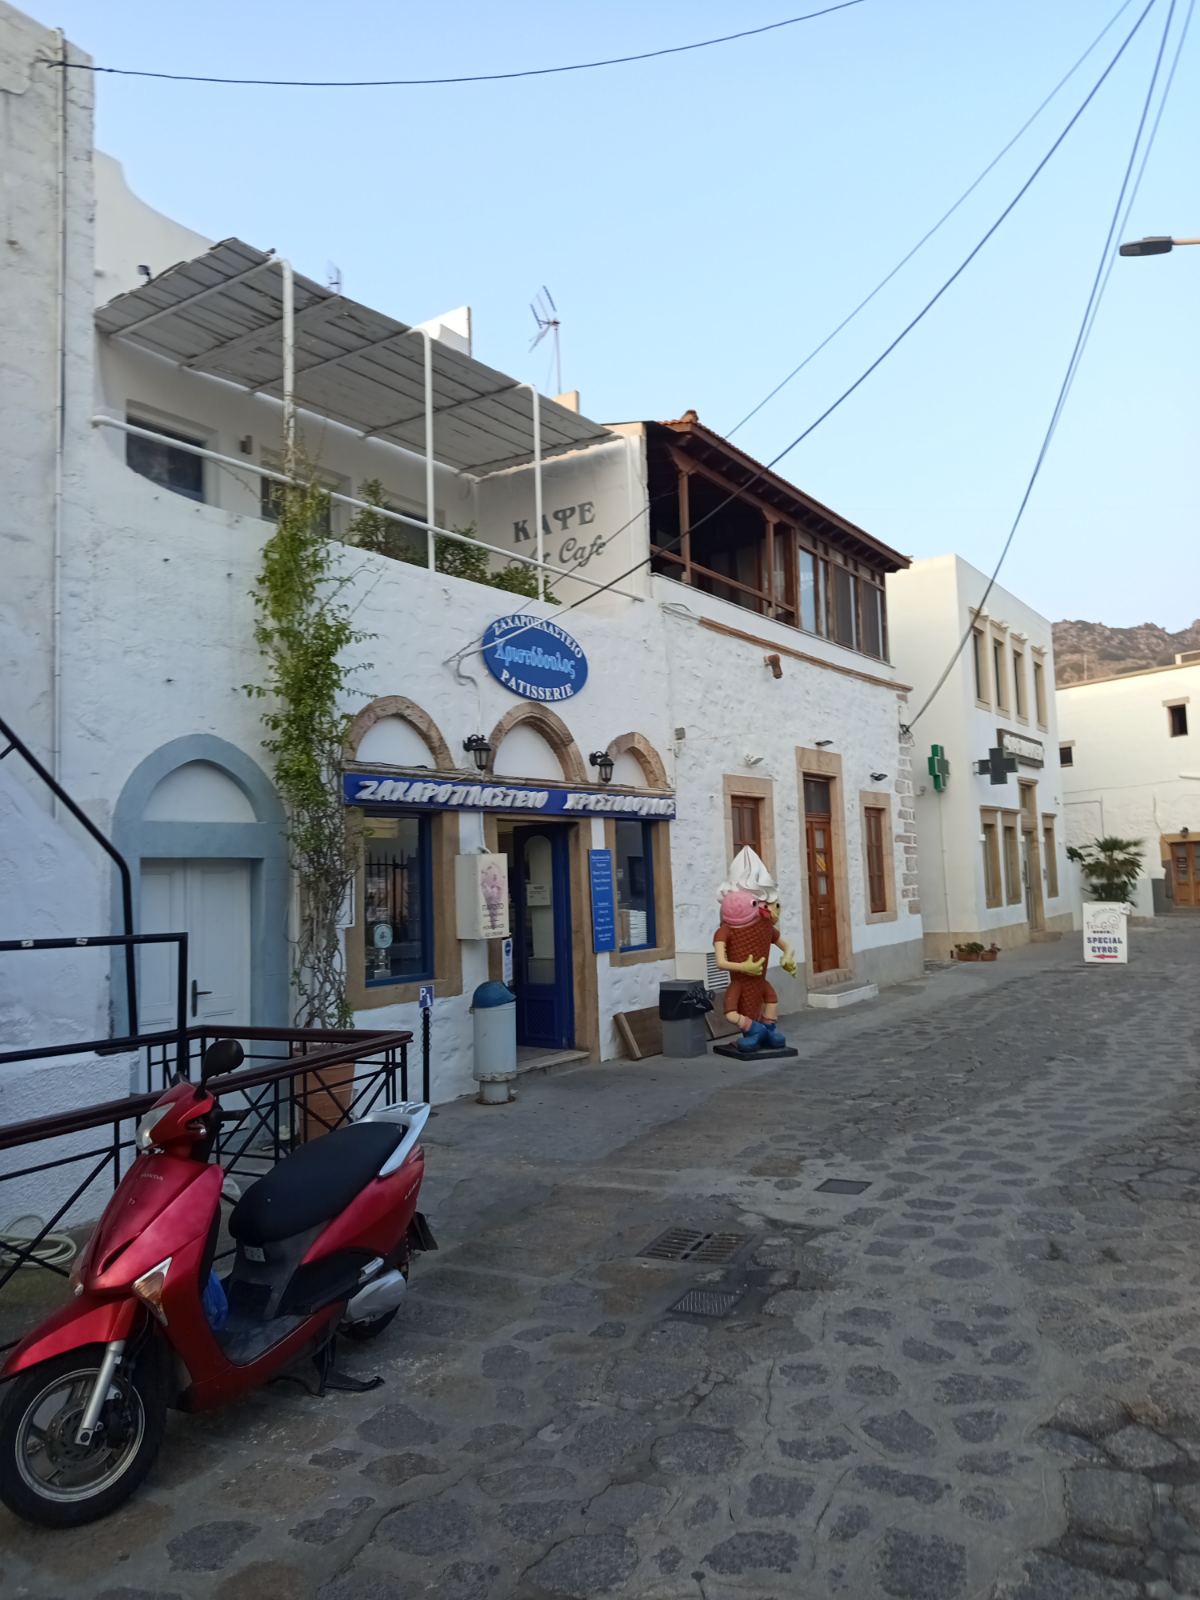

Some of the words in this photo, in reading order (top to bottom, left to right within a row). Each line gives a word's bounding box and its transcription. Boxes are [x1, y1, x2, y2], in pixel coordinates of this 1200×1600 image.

[559, 534, 606, 567] Cafe
[500, 668, 574, 700] PATISSERIE
[419, 987, 427, 1001] P
